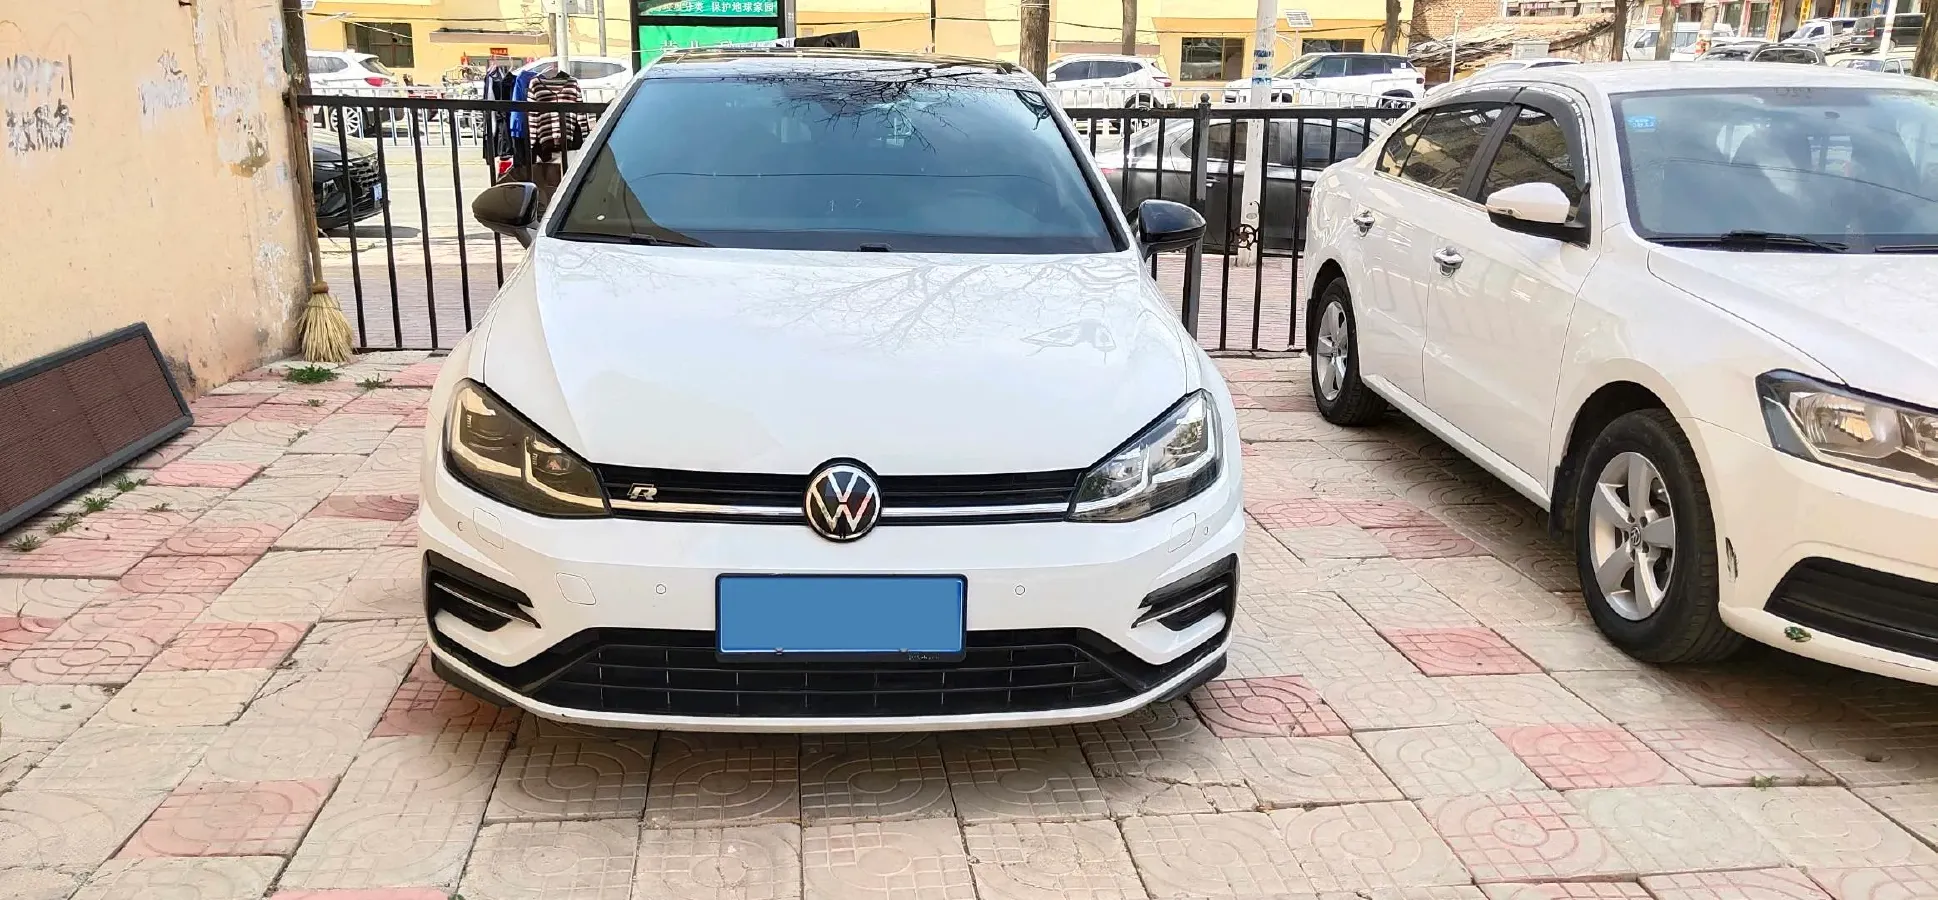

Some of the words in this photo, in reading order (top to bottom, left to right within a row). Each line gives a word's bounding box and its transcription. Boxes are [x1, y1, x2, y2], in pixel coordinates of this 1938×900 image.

[711, 1, 774, 13] 保护地球家园
[627, 482, 658, 501] R
[809, 469, 878, 535] VW
